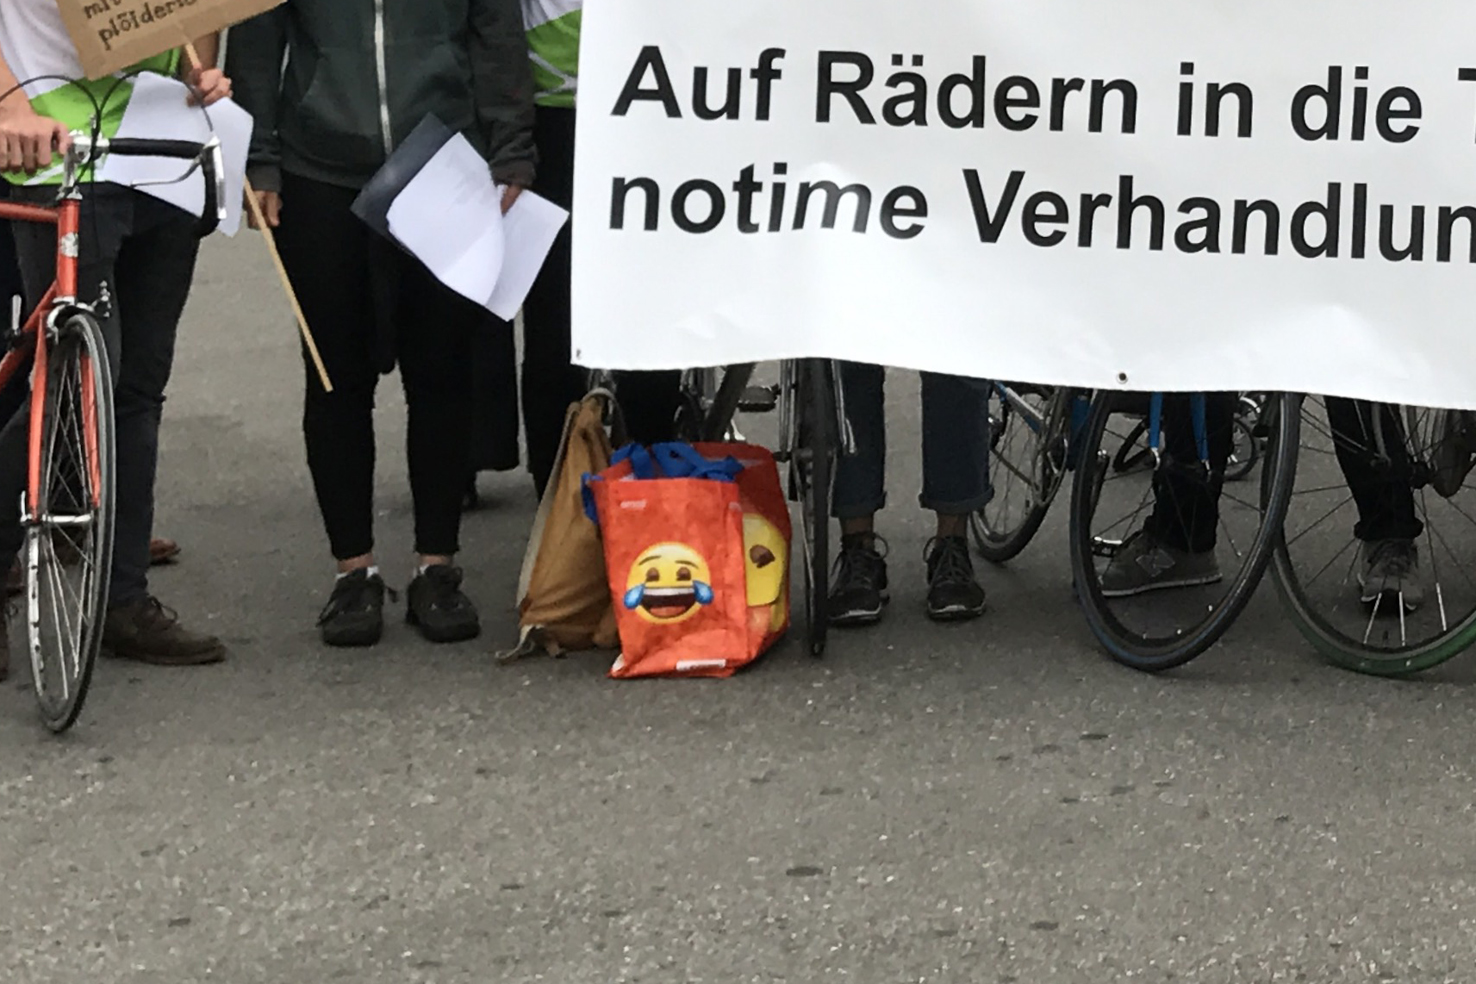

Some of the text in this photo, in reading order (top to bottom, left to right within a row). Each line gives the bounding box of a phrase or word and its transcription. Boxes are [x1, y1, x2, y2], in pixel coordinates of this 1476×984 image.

[609, 44, 787, 122] Auf
[814, 49, 1139, 135] Rädern
[1176, 61, 1254, 139] in
[1289, 64, 1424, 144] die
[608, 161, 929, 241] notime
